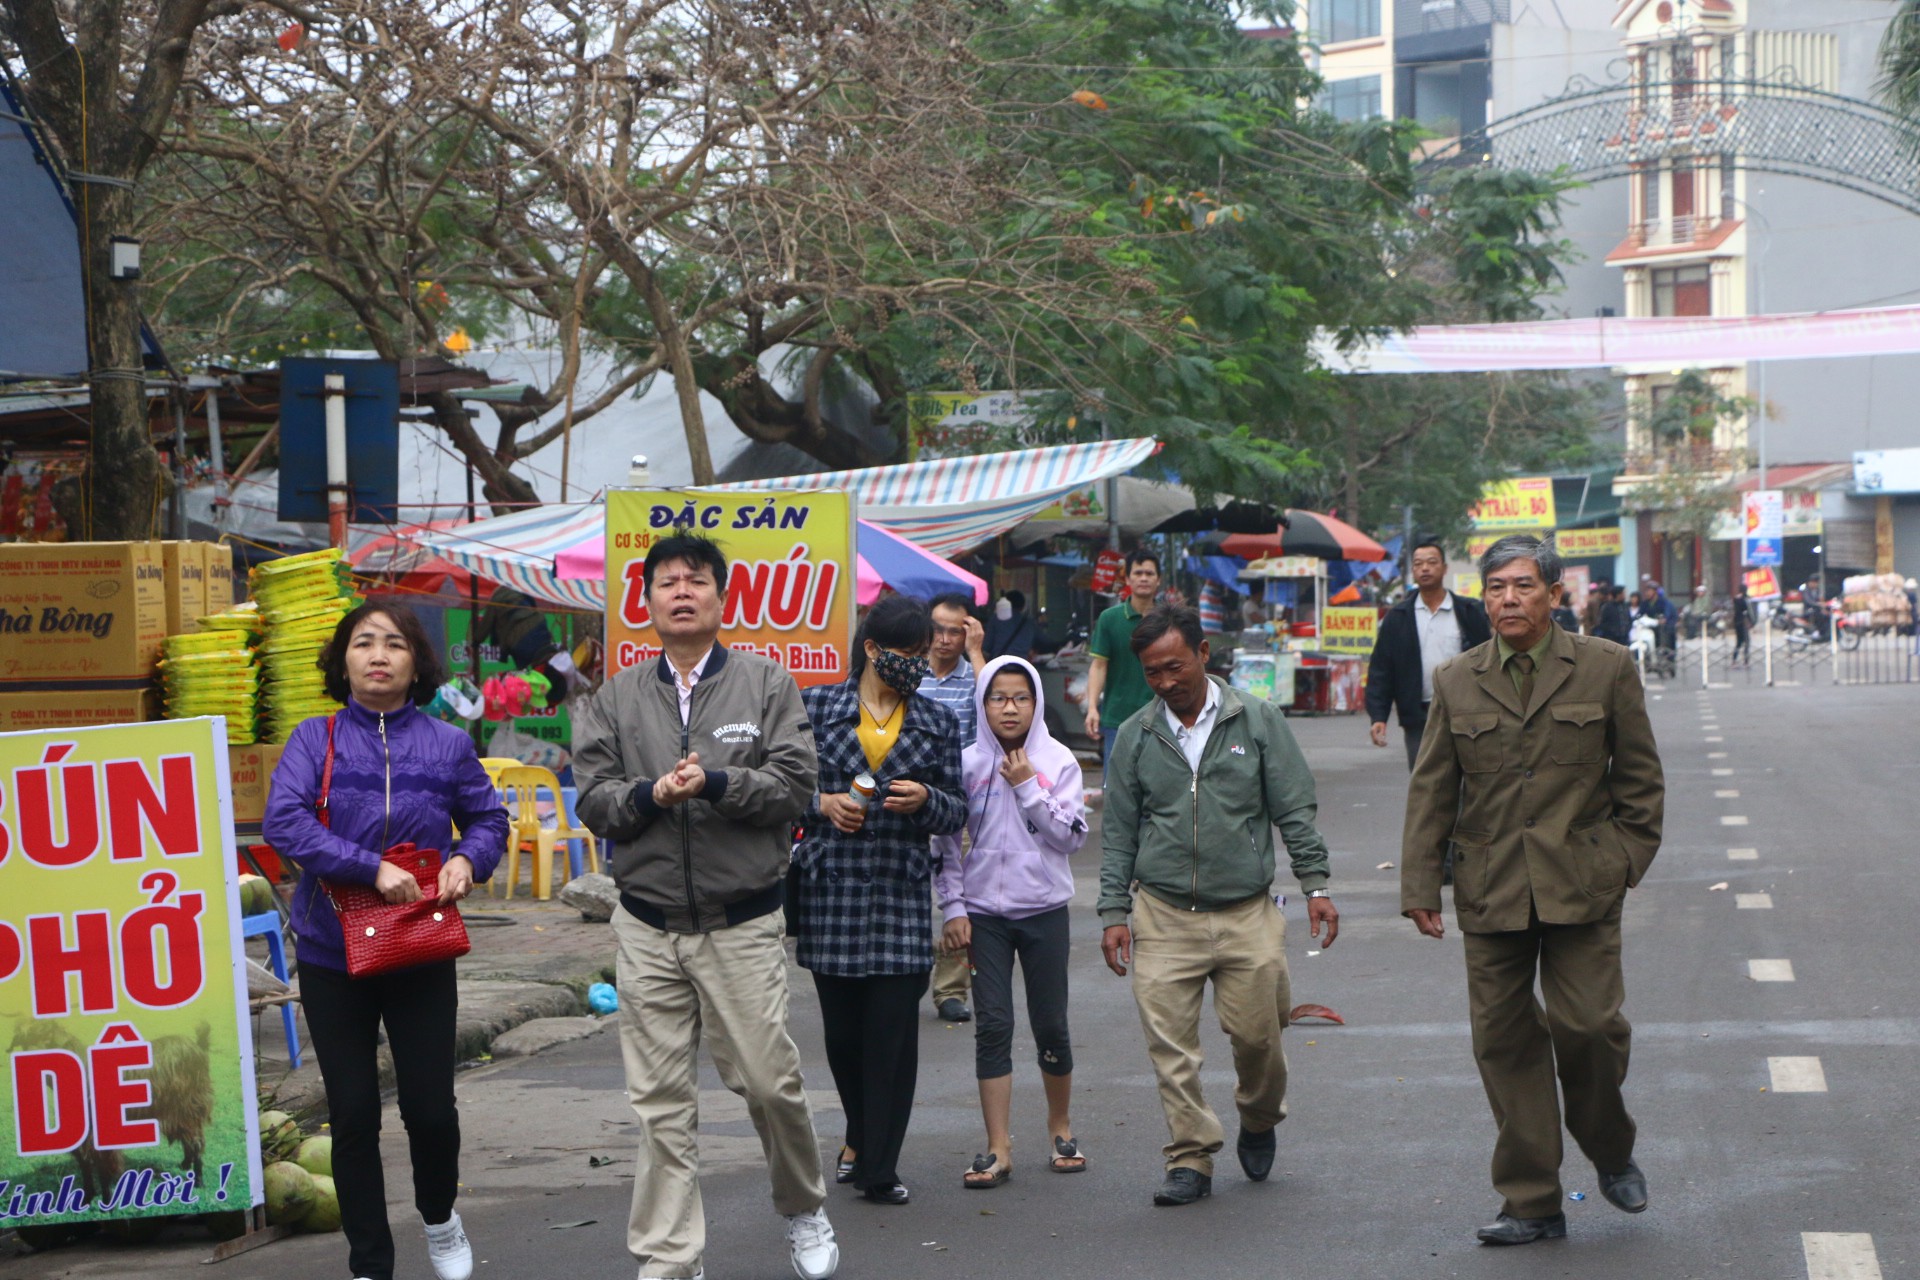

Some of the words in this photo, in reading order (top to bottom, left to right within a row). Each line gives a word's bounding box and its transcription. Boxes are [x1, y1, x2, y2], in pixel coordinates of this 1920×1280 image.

[951, 399, 978, 415] Tea
[732, 498, 809, 529] SẢN
[721, 545, 836, 627] NÚI
[0, 605, 33, 634] hà
[39, 606, 114, 638] Bông
[788, 645, 838, 671] Bình
[1231, 745, 1245, 755] FILA
[0, 742, 200, 867] ÚN
[13, 1023, 160, 1154] DÊ
[98, 1168, 199, 1211] Mời
[216, 1163, 234, 1201] !
